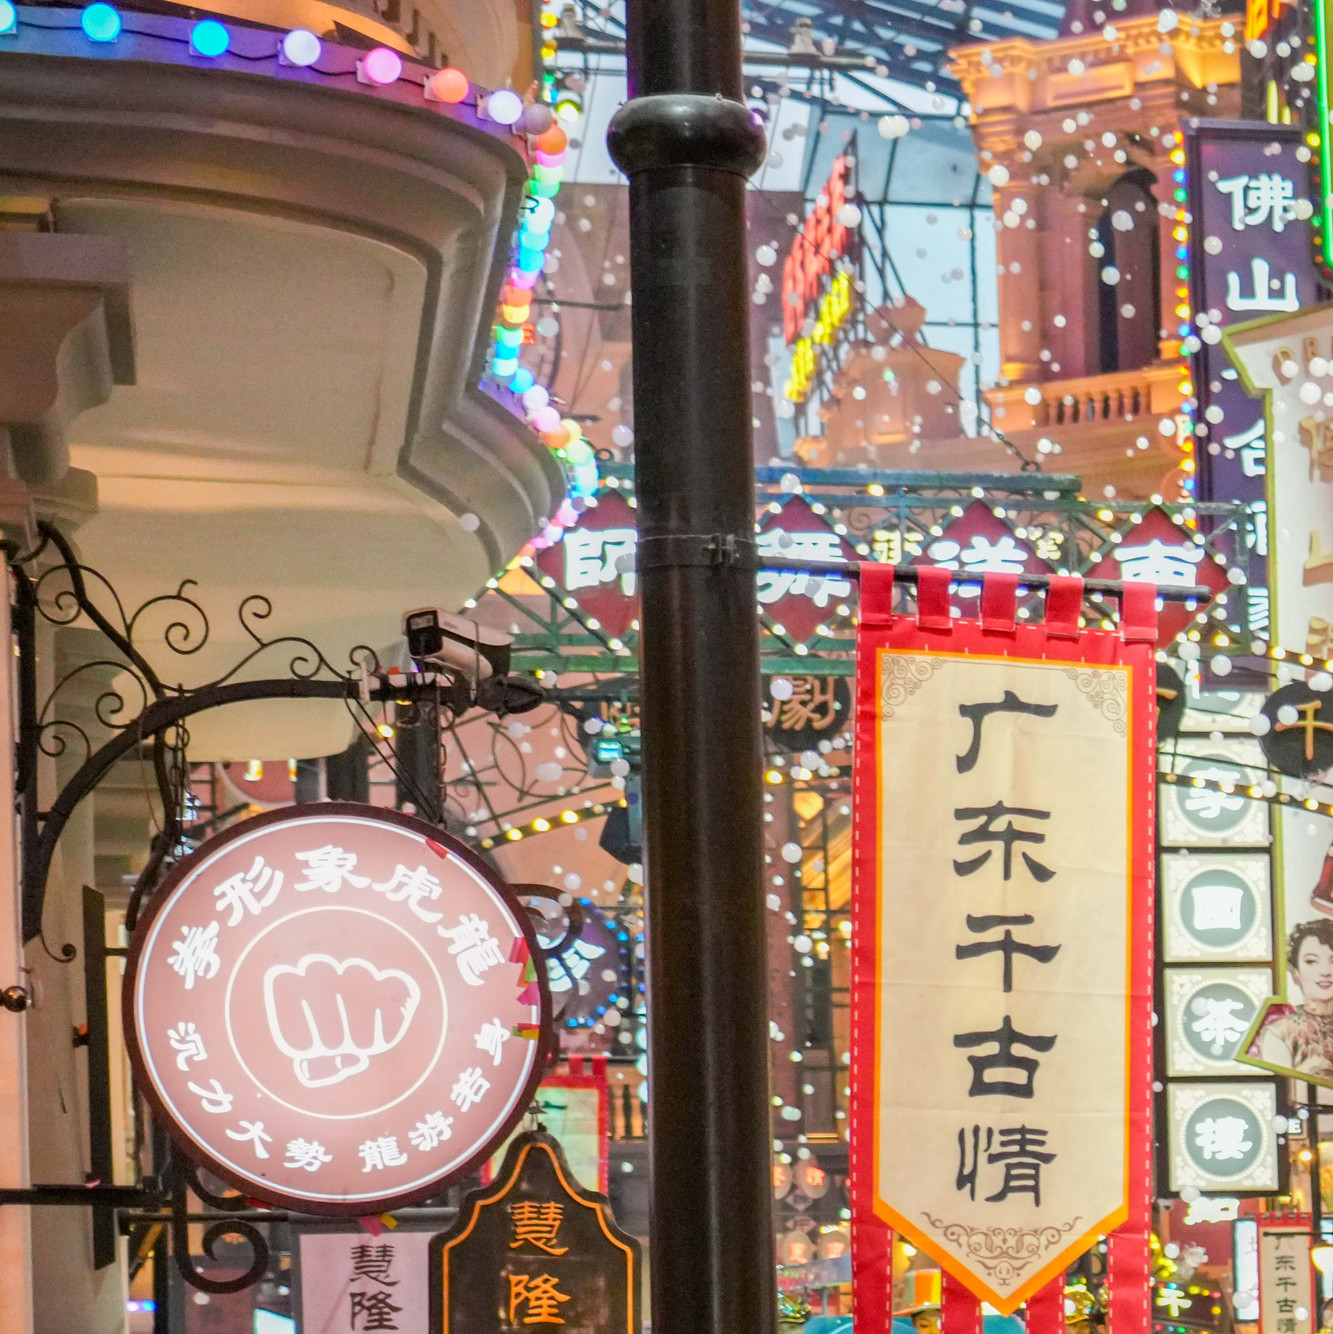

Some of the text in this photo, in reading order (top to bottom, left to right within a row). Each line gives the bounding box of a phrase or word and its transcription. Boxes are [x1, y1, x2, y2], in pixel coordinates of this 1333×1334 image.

[953, 690, 1062, 1207] 广东千古情
